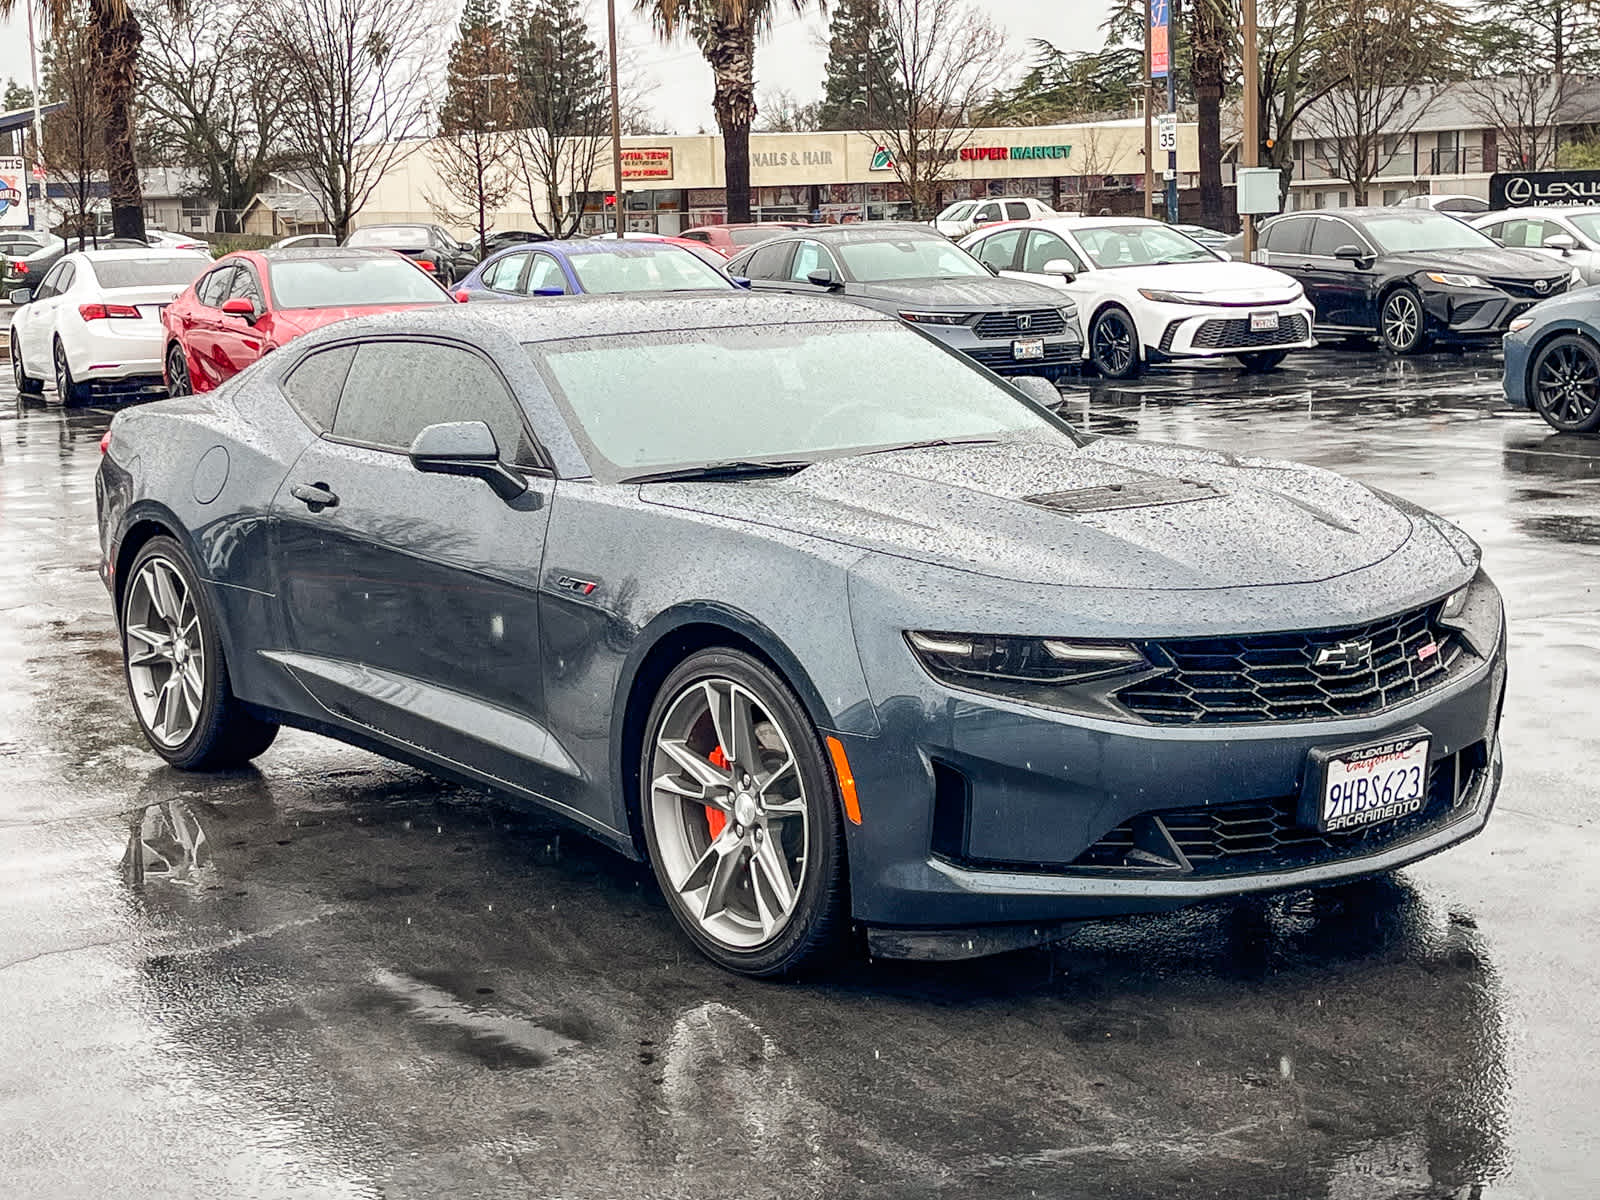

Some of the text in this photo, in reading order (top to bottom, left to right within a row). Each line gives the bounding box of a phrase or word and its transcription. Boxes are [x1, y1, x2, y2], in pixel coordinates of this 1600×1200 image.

[1161, 133, 1175, 147] 35
[752, 151, 833, 167] NAILS & HAIR
[960, 147, 1008, 161] SUPER
[1010, 145, 1072, 160] MARKET
[1534, 182, 1600, 196] LEXU
[1360, 740, 1410, 759] LEXUS OF
[1328, 765, 1421, 818] 9HBS623
[1326, 799, 1421, 832] SACRAMENTO
